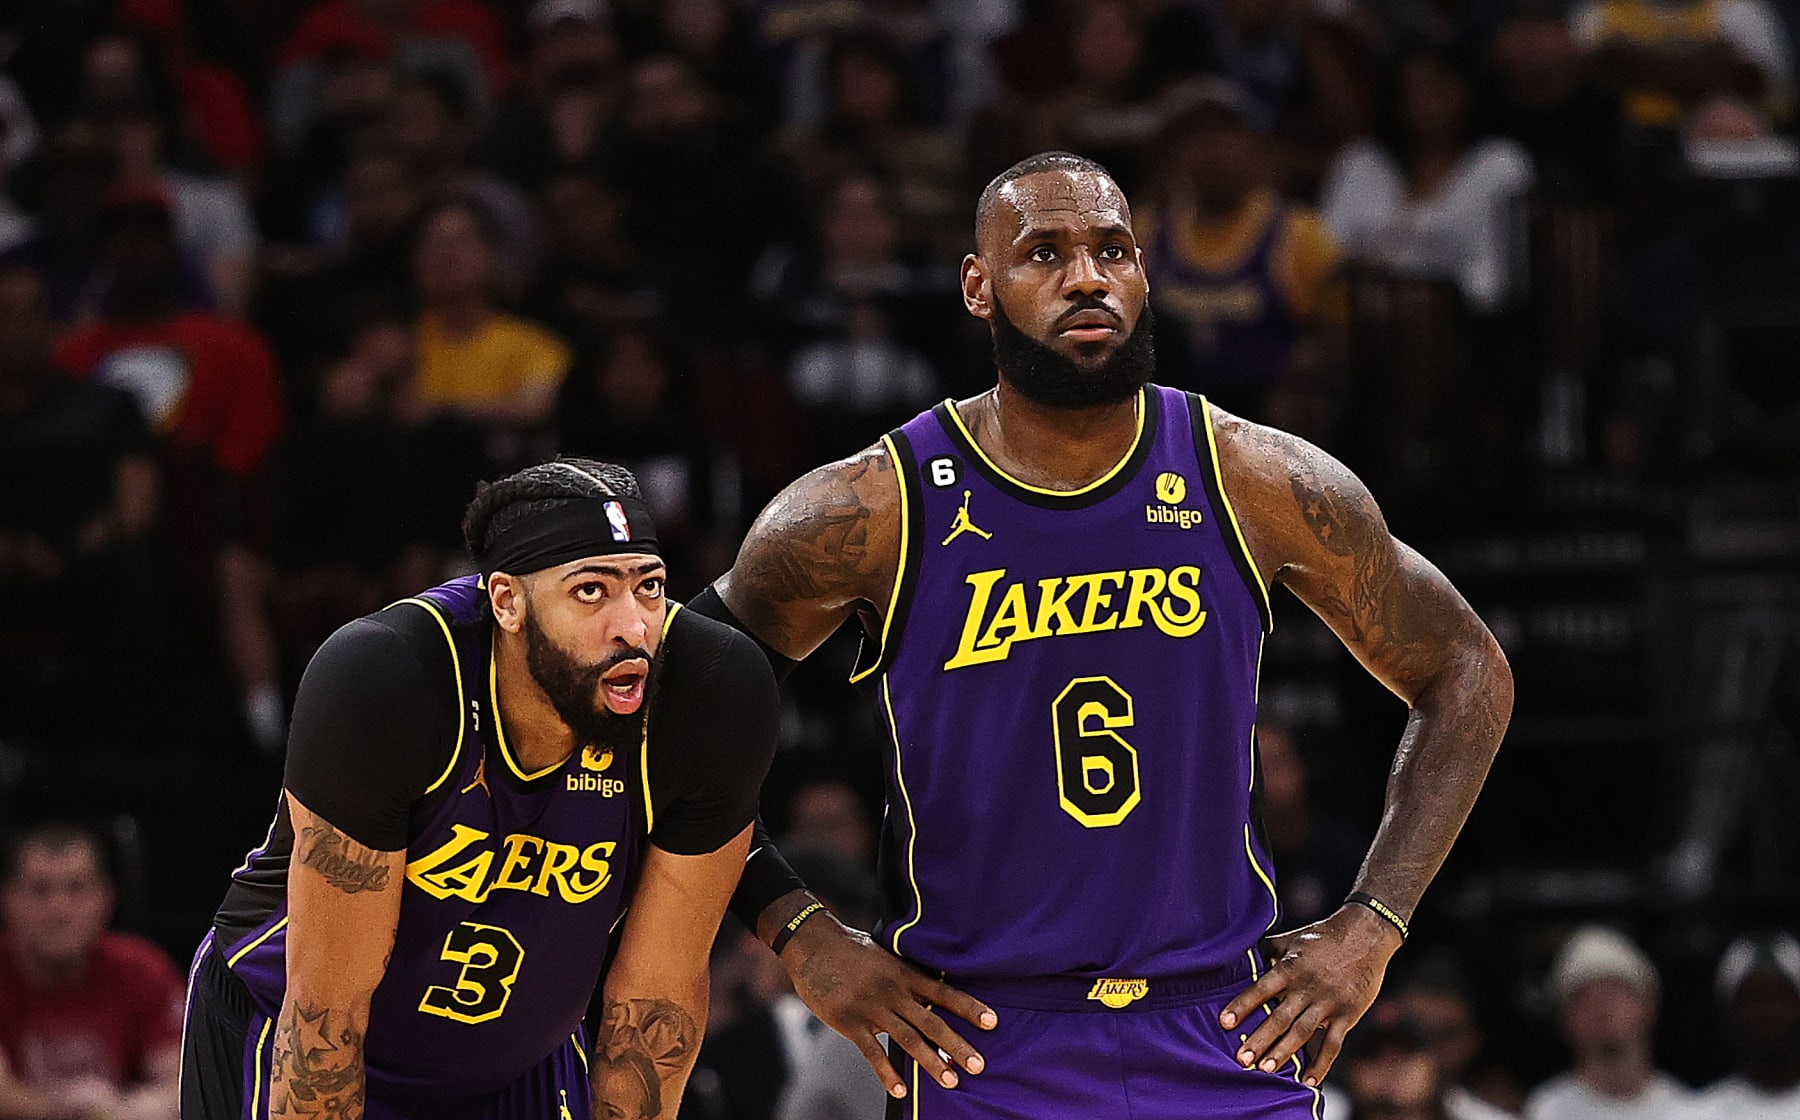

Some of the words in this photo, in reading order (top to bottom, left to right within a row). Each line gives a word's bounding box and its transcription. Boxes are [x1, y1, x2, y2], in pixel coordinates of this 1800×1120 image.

[930, 458, 956, 486] 6
[1146, 505, 1203, 529] bibigo
[943, 565, 1208, 671] LAKERS
[1051, 675, 1142, 828] 6
[566, 773, 624, 798] bibigo
[405, 823, 617, 904] LAERS
[418, 921, 525, 1024] 3
[1093, 979, 1145, 997] LAKERS
